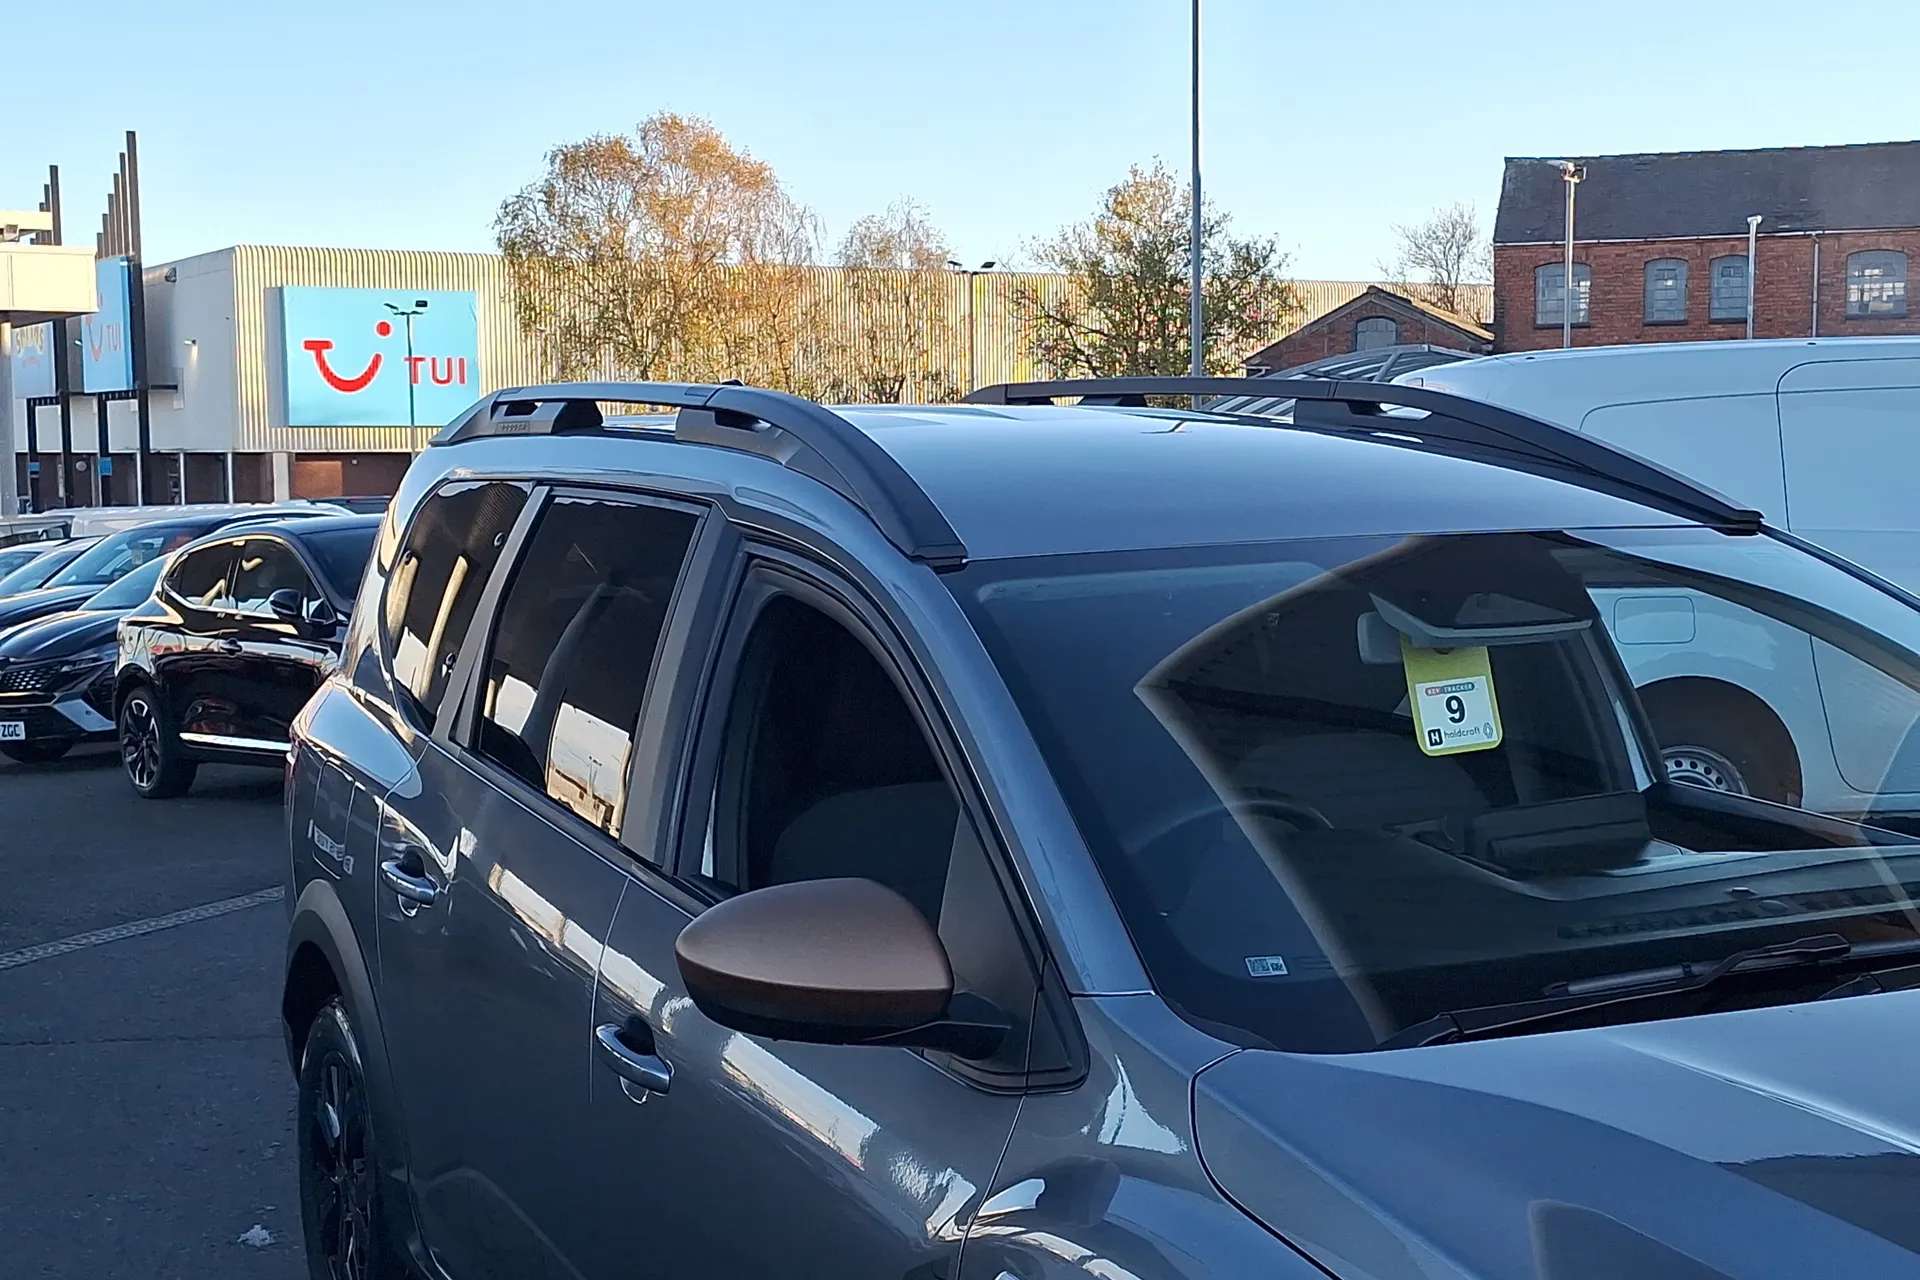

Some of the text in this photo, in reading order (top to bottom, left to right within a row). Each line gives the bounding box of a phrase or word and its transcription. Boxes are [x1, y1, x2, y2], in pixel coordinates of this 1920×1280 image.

[404, 357, 467, 385] TUI
[1445, 695, 1465, 723] 9
[1, 724, 21, 738] ZGC
[1430, 727, 1480, 745] H holdcroft
